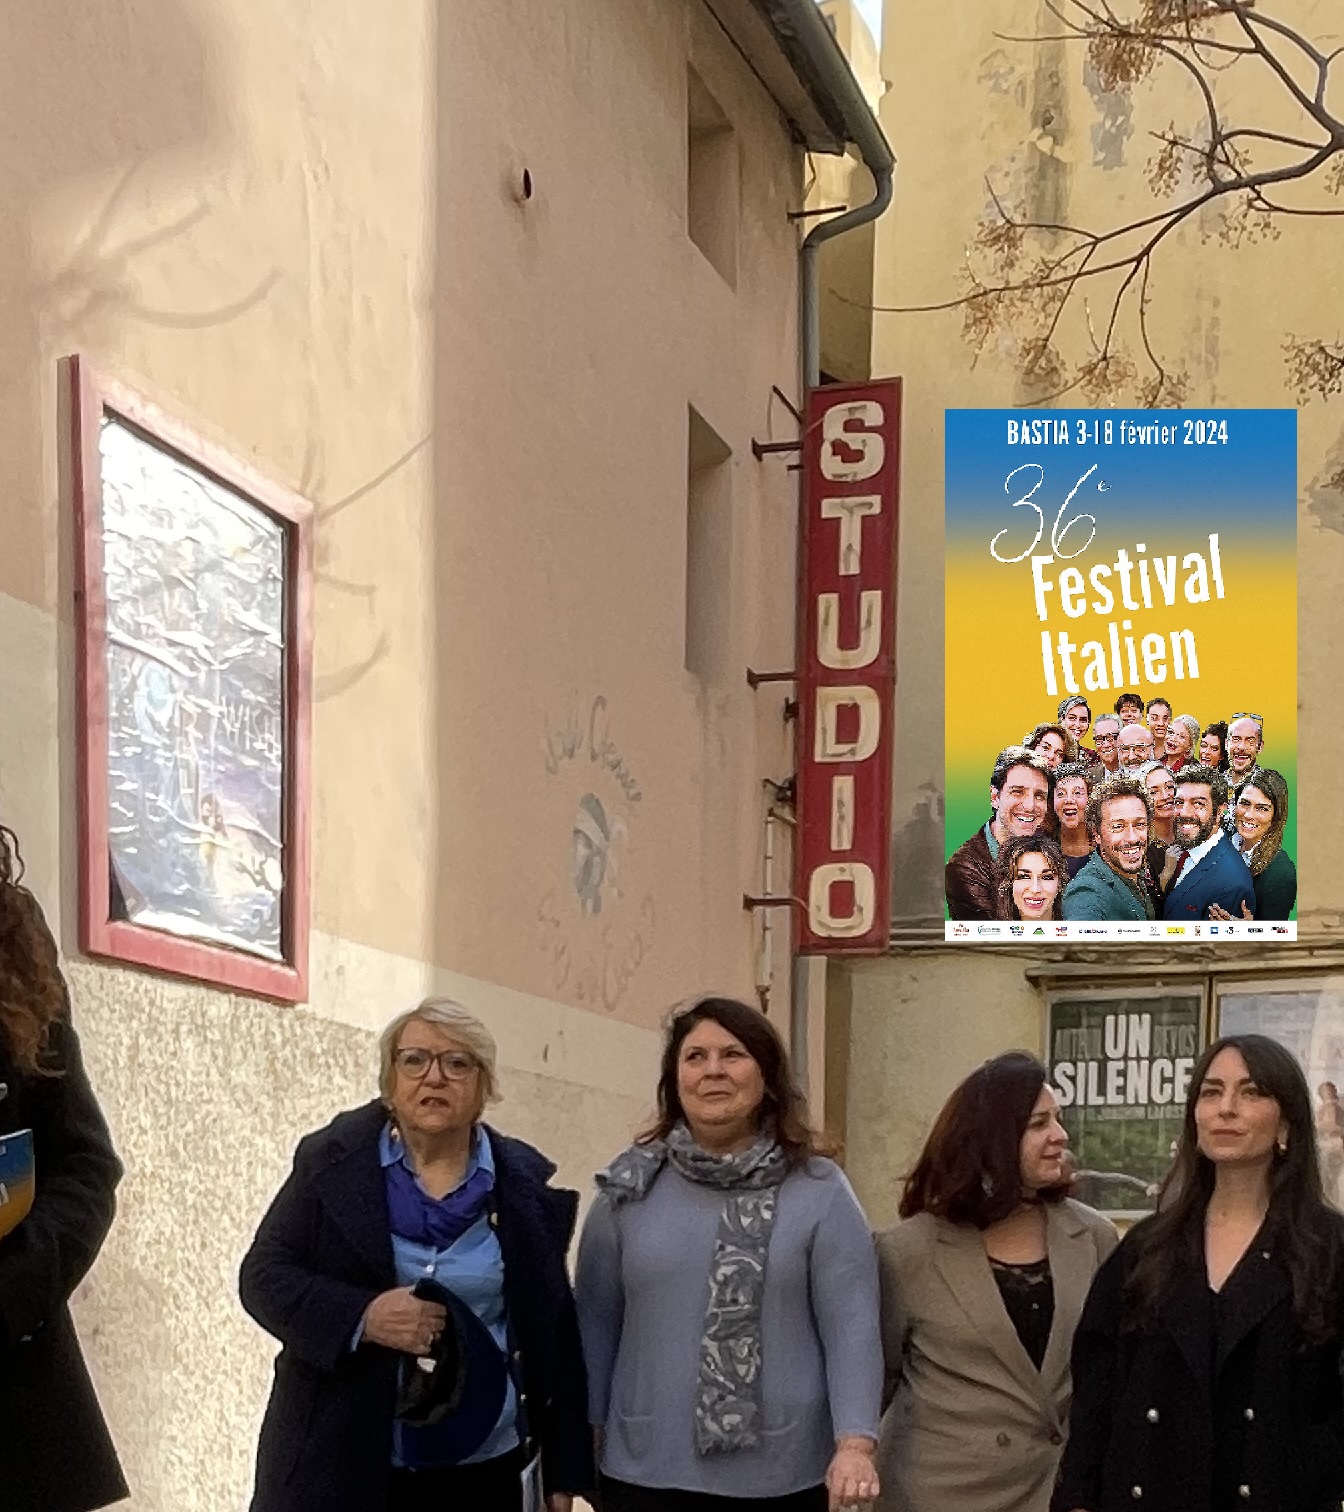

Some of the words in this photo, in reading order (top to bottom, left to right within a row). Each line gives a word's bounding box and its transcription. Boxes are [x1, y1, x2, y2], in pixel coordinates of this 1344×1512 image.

[1007, 420, 1069, 446] BASTIA
[1076, 419, 1114, 446] 3-18
[1119, 419, 1178, 446] février
[1183, 419, 1229, 446] 2024
[1031, 533, 1226, 622] Festival
[807, 400, 885, 939] STUDIO
[1041, 621, 1201, 697] Italien
[1104, 1013, 1152, 1059] UN
[1053, 1057, 1194, 1107] SILENCE
